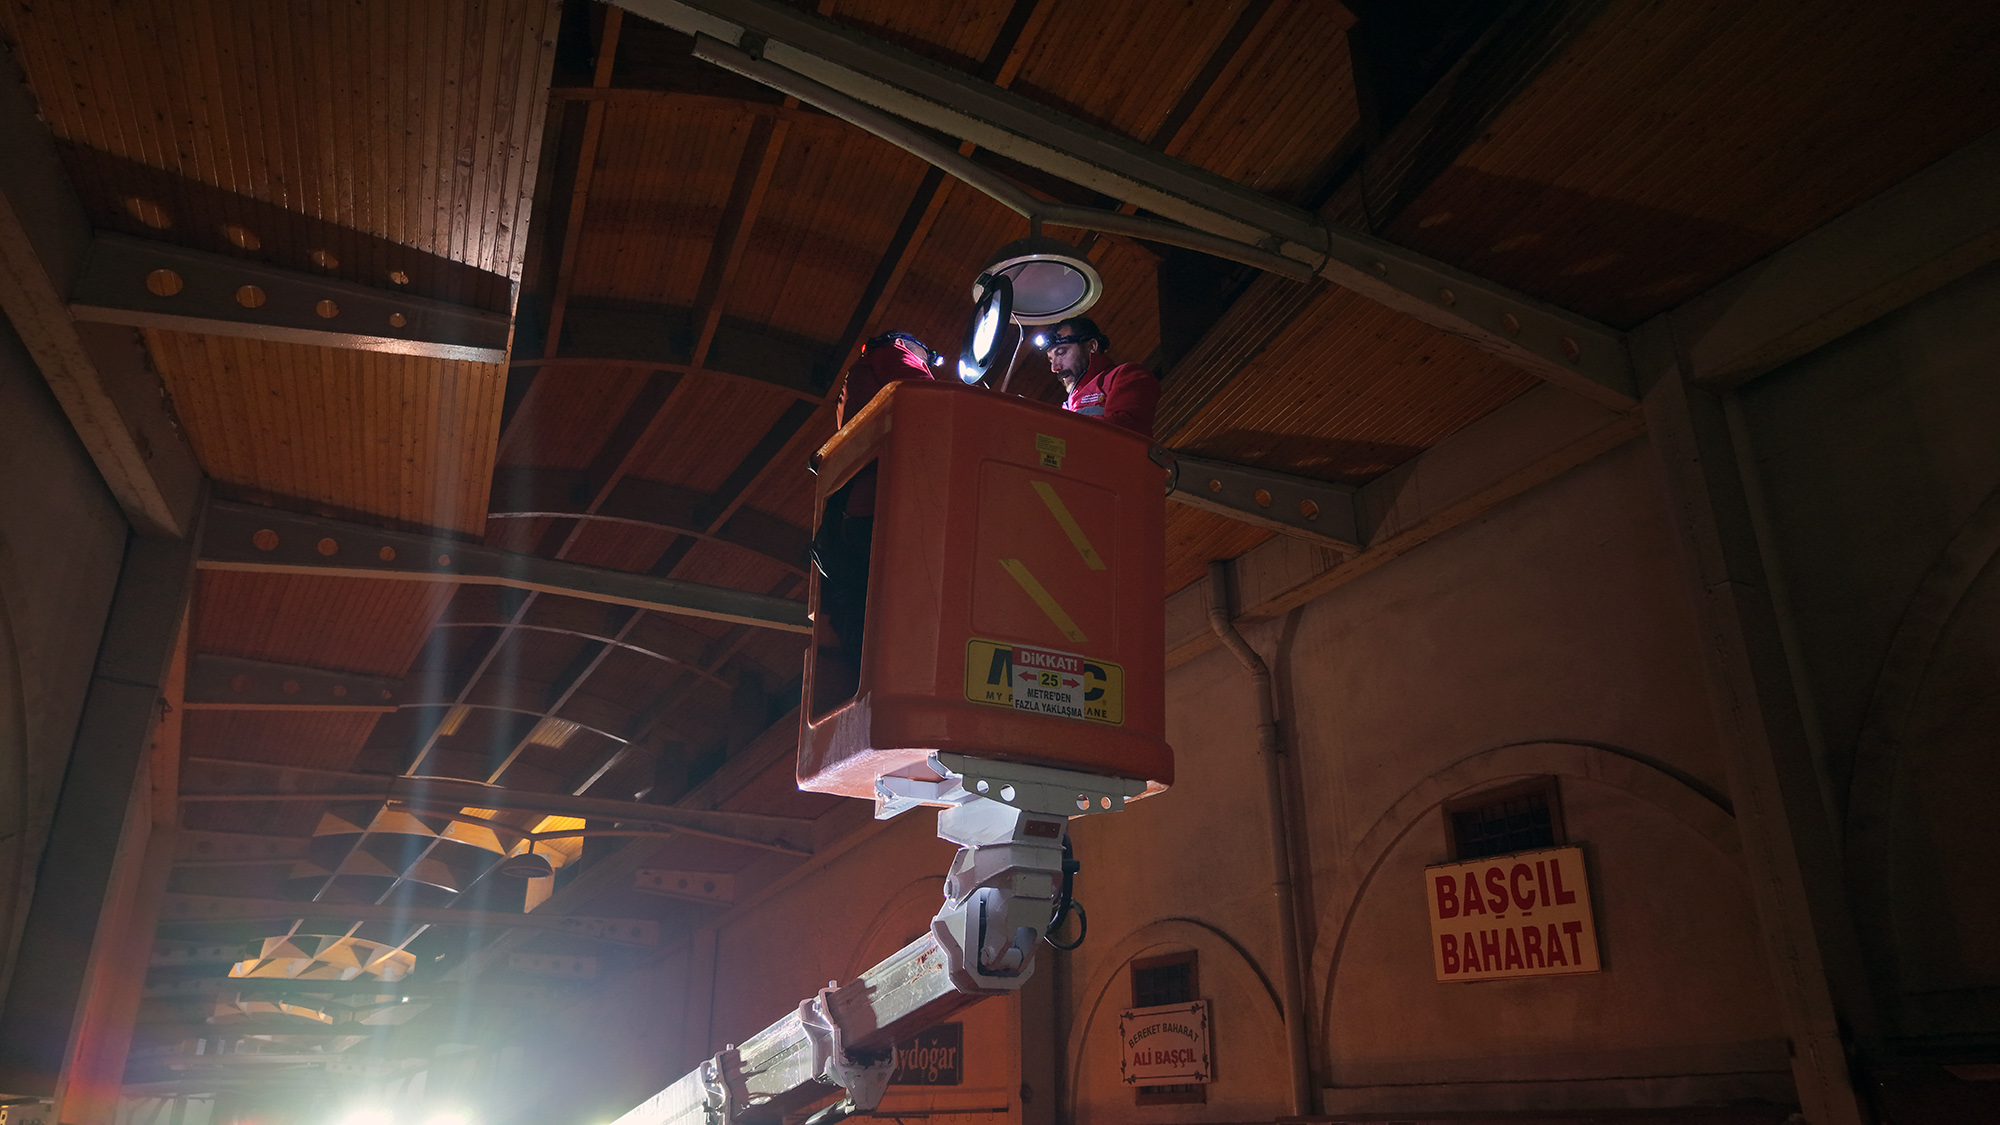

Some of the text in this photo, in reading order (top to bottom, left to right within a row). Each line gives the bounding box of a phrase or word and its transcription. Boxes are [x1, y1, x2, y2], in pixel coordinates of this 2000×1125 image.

[1041, 673, 1058, 687] 25
[1015, 699, 1082, 718] FAZLA YAKLAŞMA
[1435, 859, 1576, 919] BAŞÇIL
[1440, 921, 1582, 974] BAHARAT
[1128, 1023, 1199, 1049] BEREKET BAHARAT
[1133, 1047, 1197, 1069] ALİ BAŞÇIL
